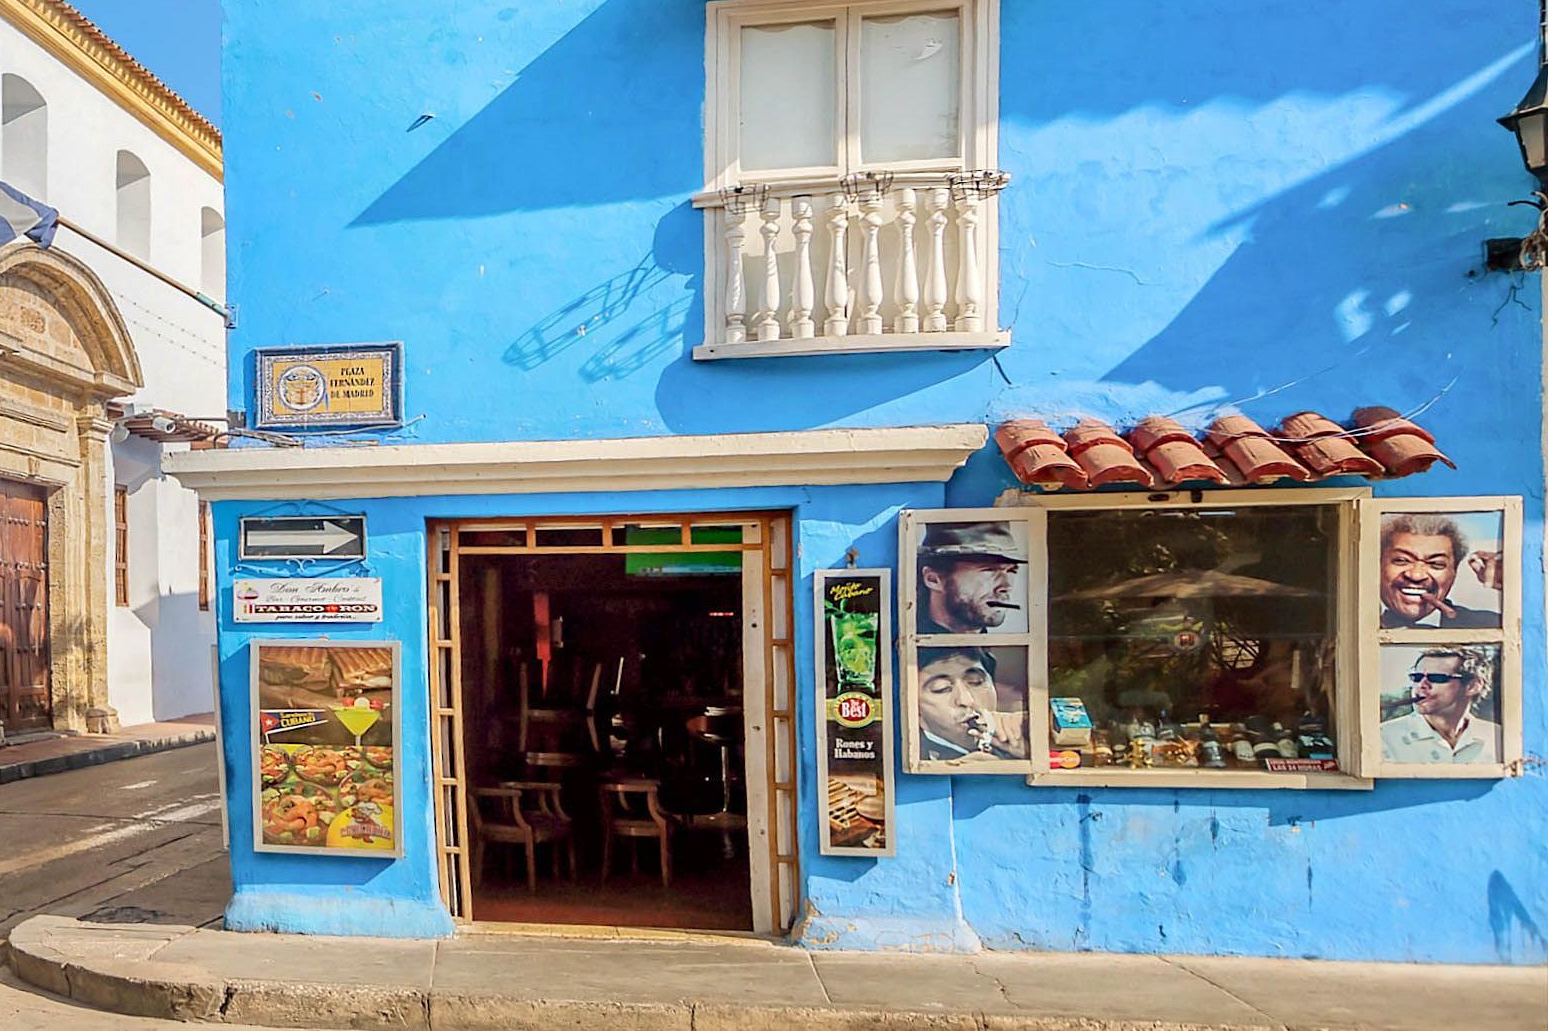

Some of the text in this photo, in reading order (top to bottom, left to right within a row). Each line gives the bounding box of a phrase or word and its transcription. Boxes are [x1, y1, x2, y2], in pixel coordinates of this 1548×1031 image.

[341, 367, 365, 376] PLAZA
[330, 390, 374, 399] DE MADRID
[256, 605, 325, 613] TABACO
[338, 604, 376, 613] RON
[841, 702, 867, 718] Best
[835, 737, 874, 751] Rones y
[834, 748, 876, 759] Habanos
